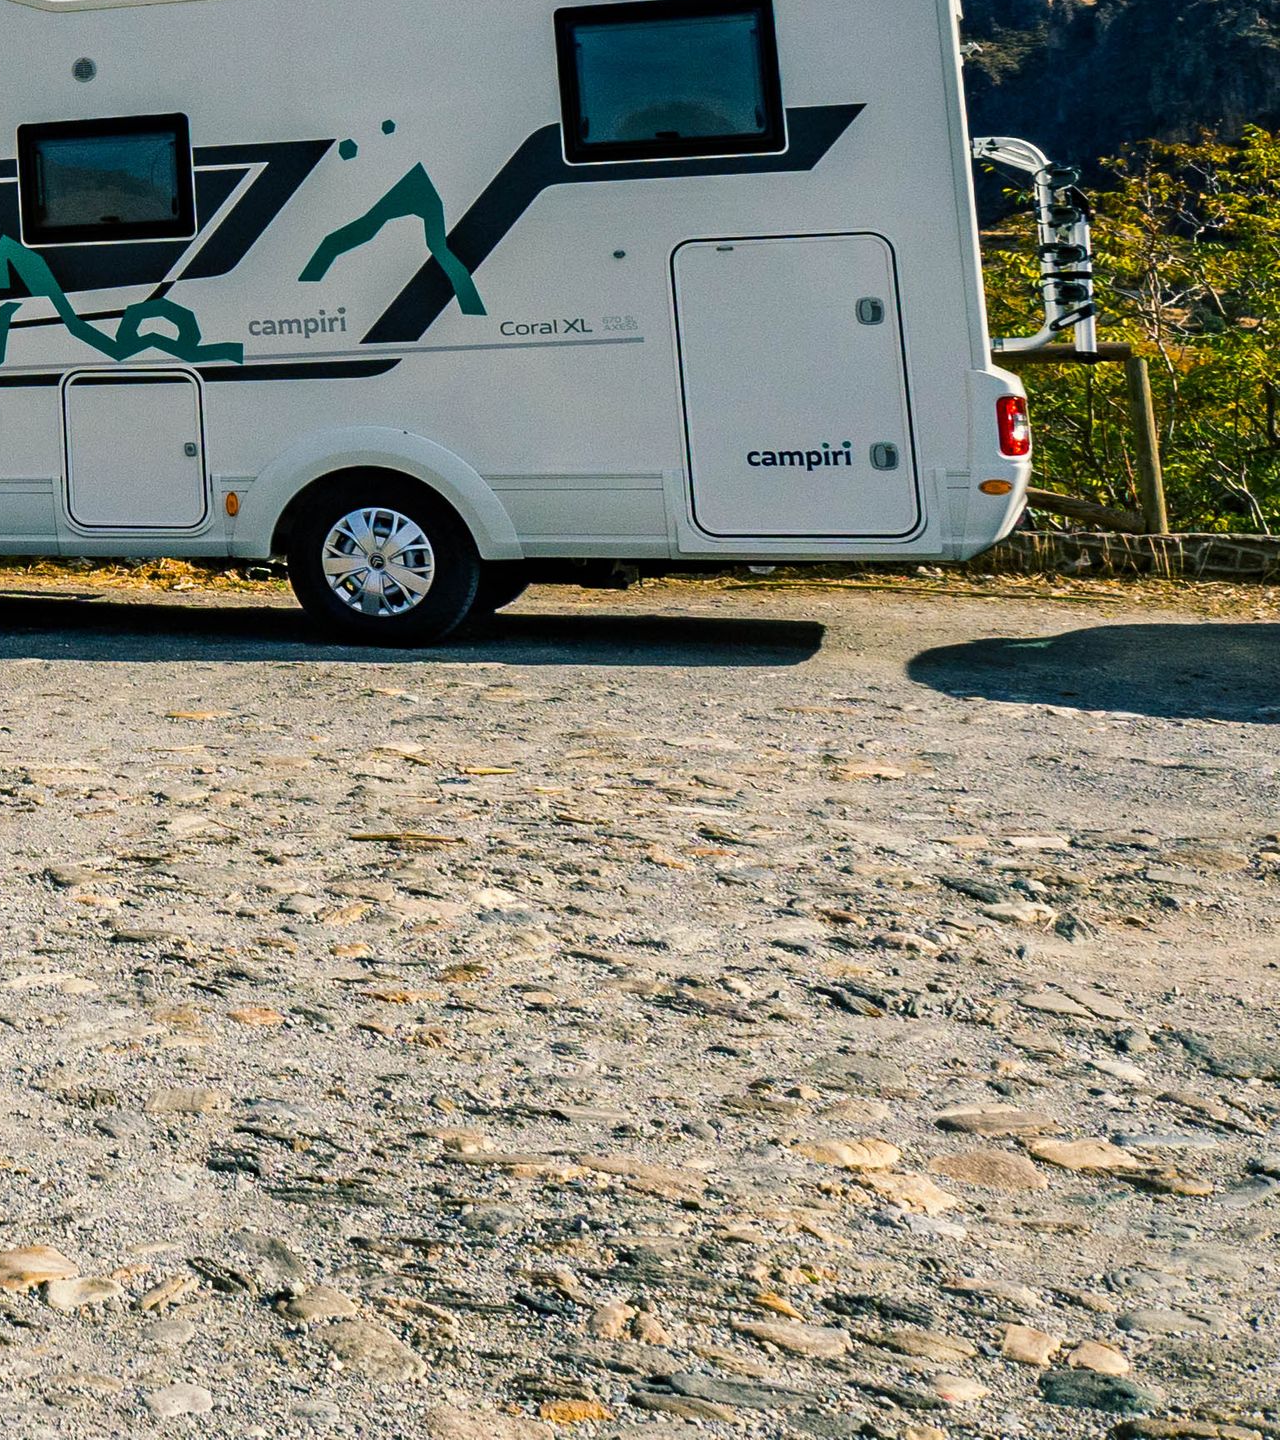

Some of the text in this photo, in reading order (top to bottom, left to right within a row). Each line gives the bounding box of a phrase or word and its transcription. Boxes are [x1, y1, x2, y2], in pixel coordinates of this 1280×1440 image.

[248, 307, 347, 339] campiri
[500, 318, 593, 336] Coral XL
[746, 440, 852, 471] campiri
